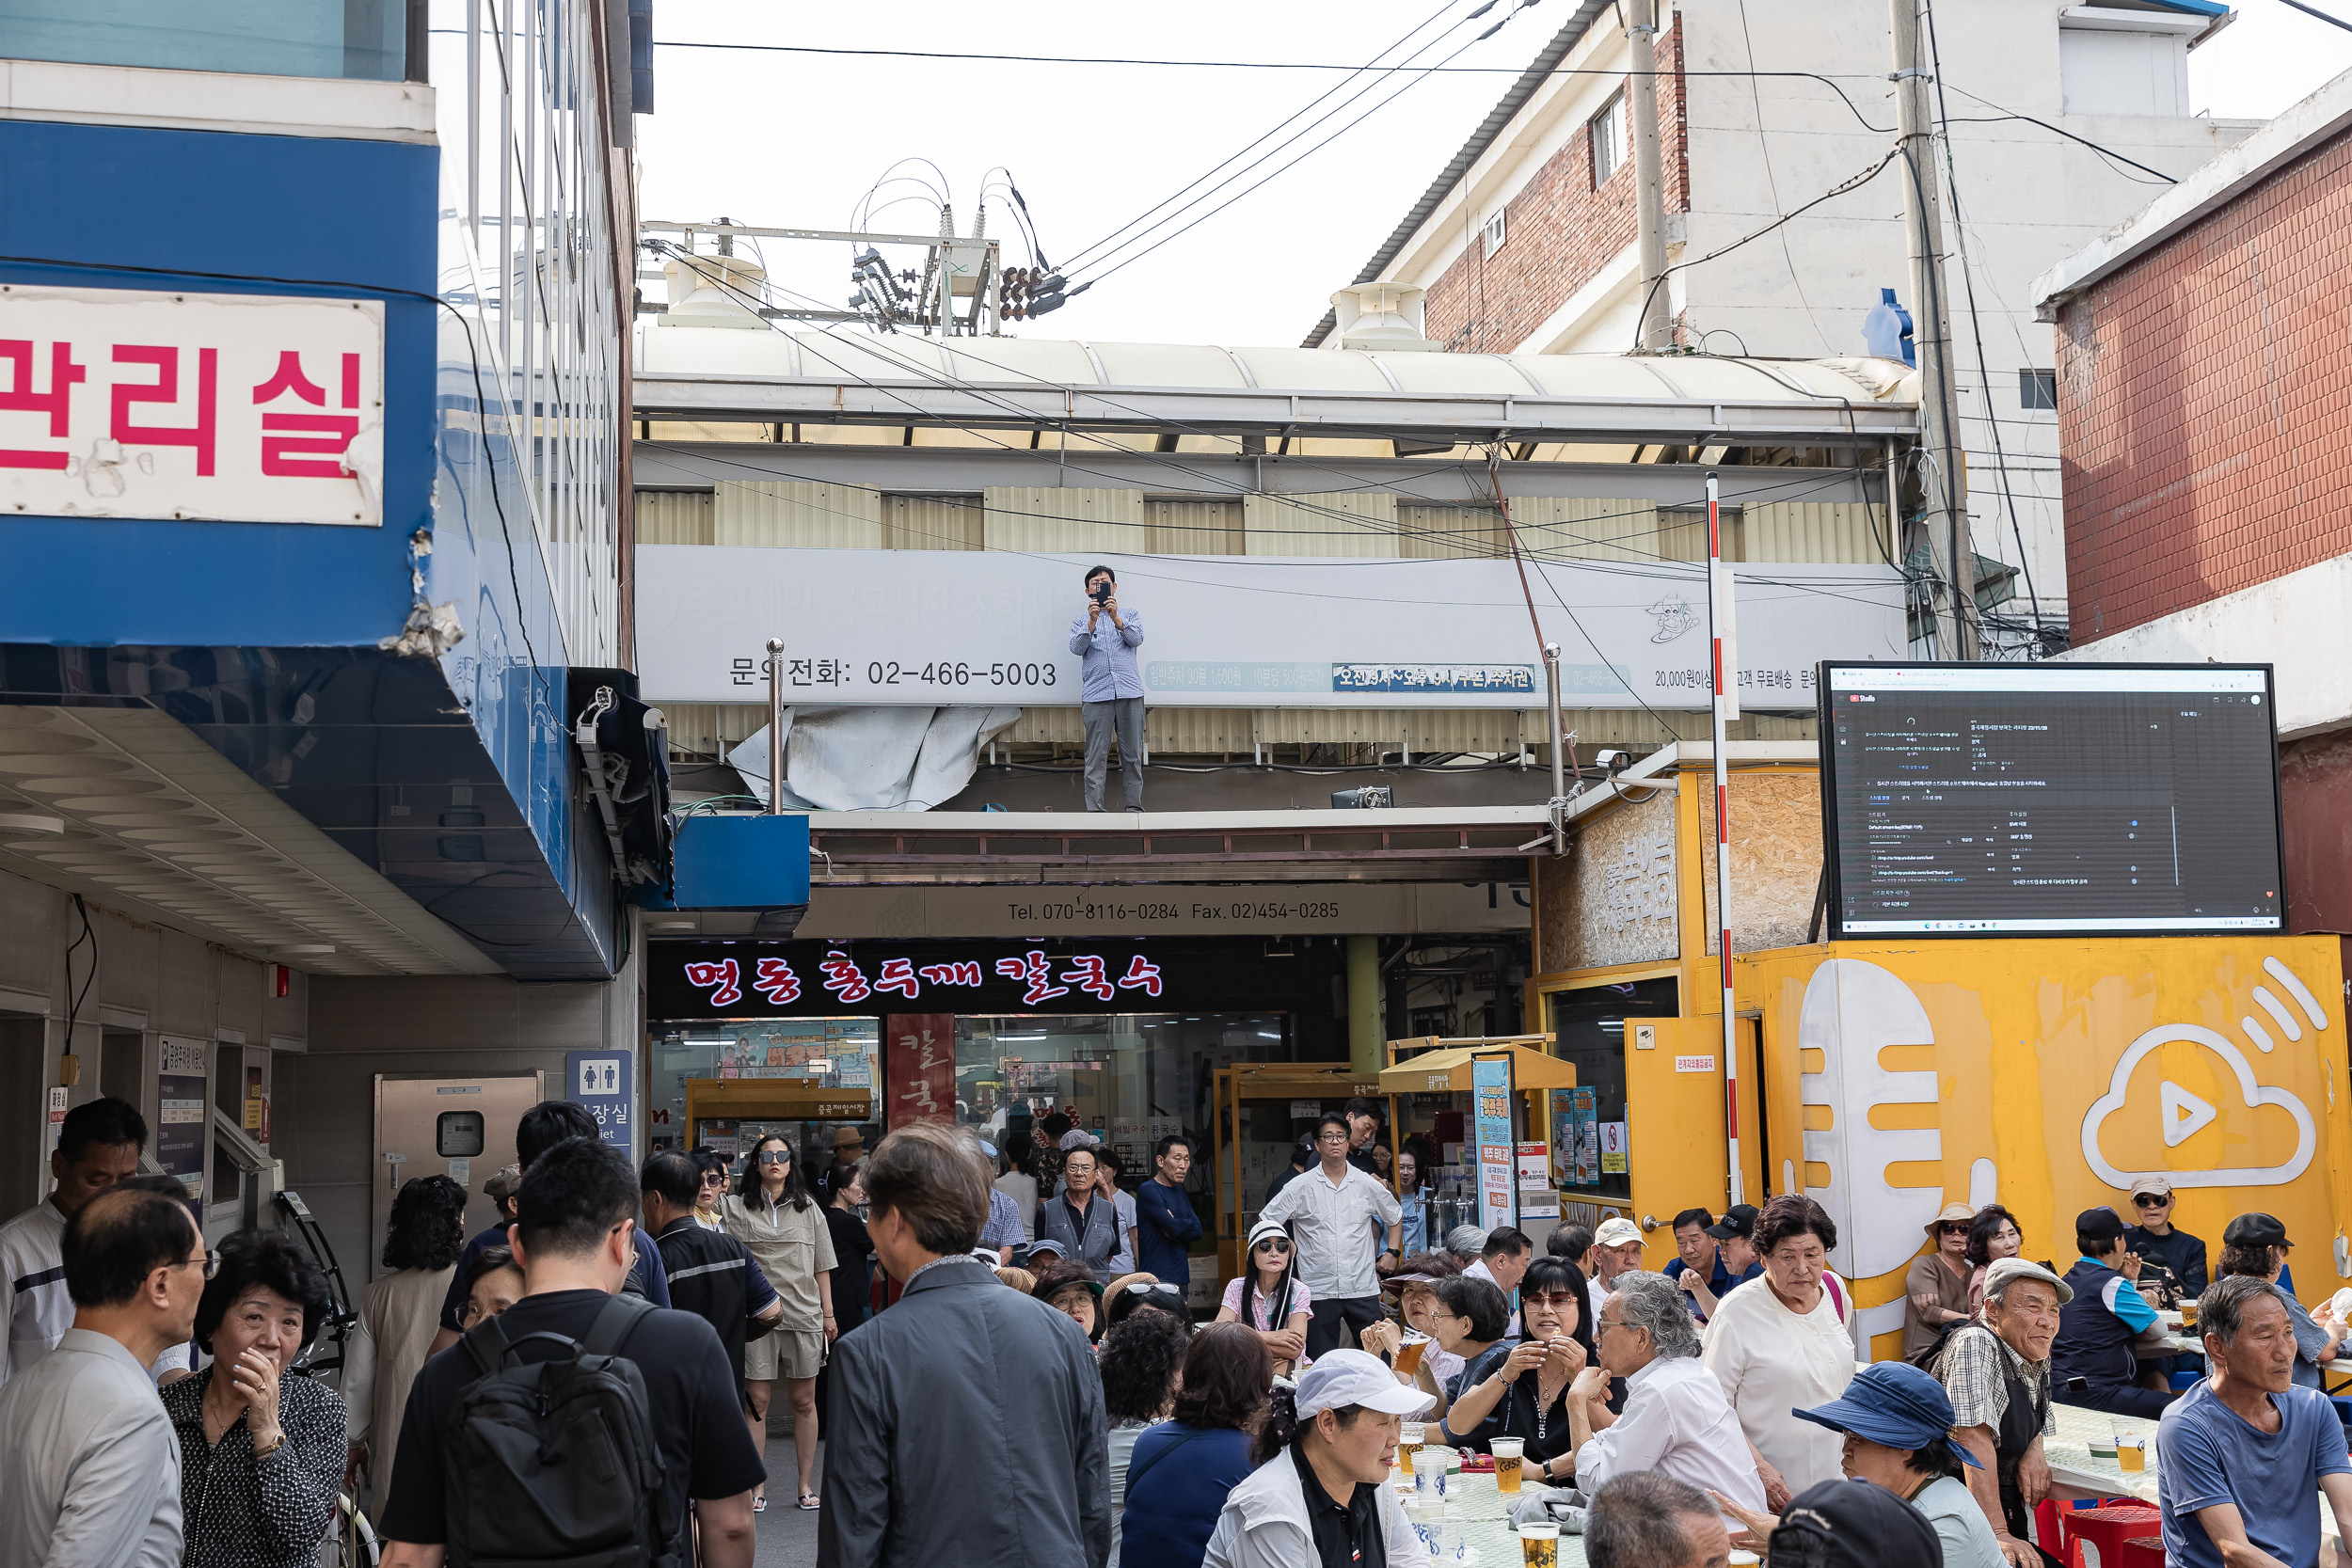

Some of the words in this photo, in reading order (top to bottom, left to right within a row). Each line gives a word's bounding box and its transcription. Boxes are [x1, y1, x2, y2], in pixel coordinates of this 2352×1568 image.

[867, 661, 1057, 686] 02-466-5003
[1150, 665, 1184, 686] 일반주차
[1187, 666, 1207, 686] 30분
[1211, 666, 1242, 687] 1,500원
[1253, 666, 1279, 687] 10분당
[1757, 669, 1792, 689] 무료배송
[1859, 694, 1876, 703] Studio
[1624, 832, 1670, 880] 보이는
[1008, 904, 1039, 920] Tel.
[1042, 903, 1180, 920] 070-8116-0284
[1192, 903, 1227, 920] Fax.
[1231, 901, 1340, 919] 02)454-0285
[1625, 877, 1673, 929] 라디오
[685, 958, 802, 1007] 명동
[820, 951, 982, 1004] 홍두깨
[995, 950, 1163, 1006] 칼국수
[899, 1029, 949, 1123] 칼국
[583, 1103, 628, 1125] 장실
[818, 1103, 866, 1116] 중곡제일시장
[600, 1129, 614, 1139] iet
